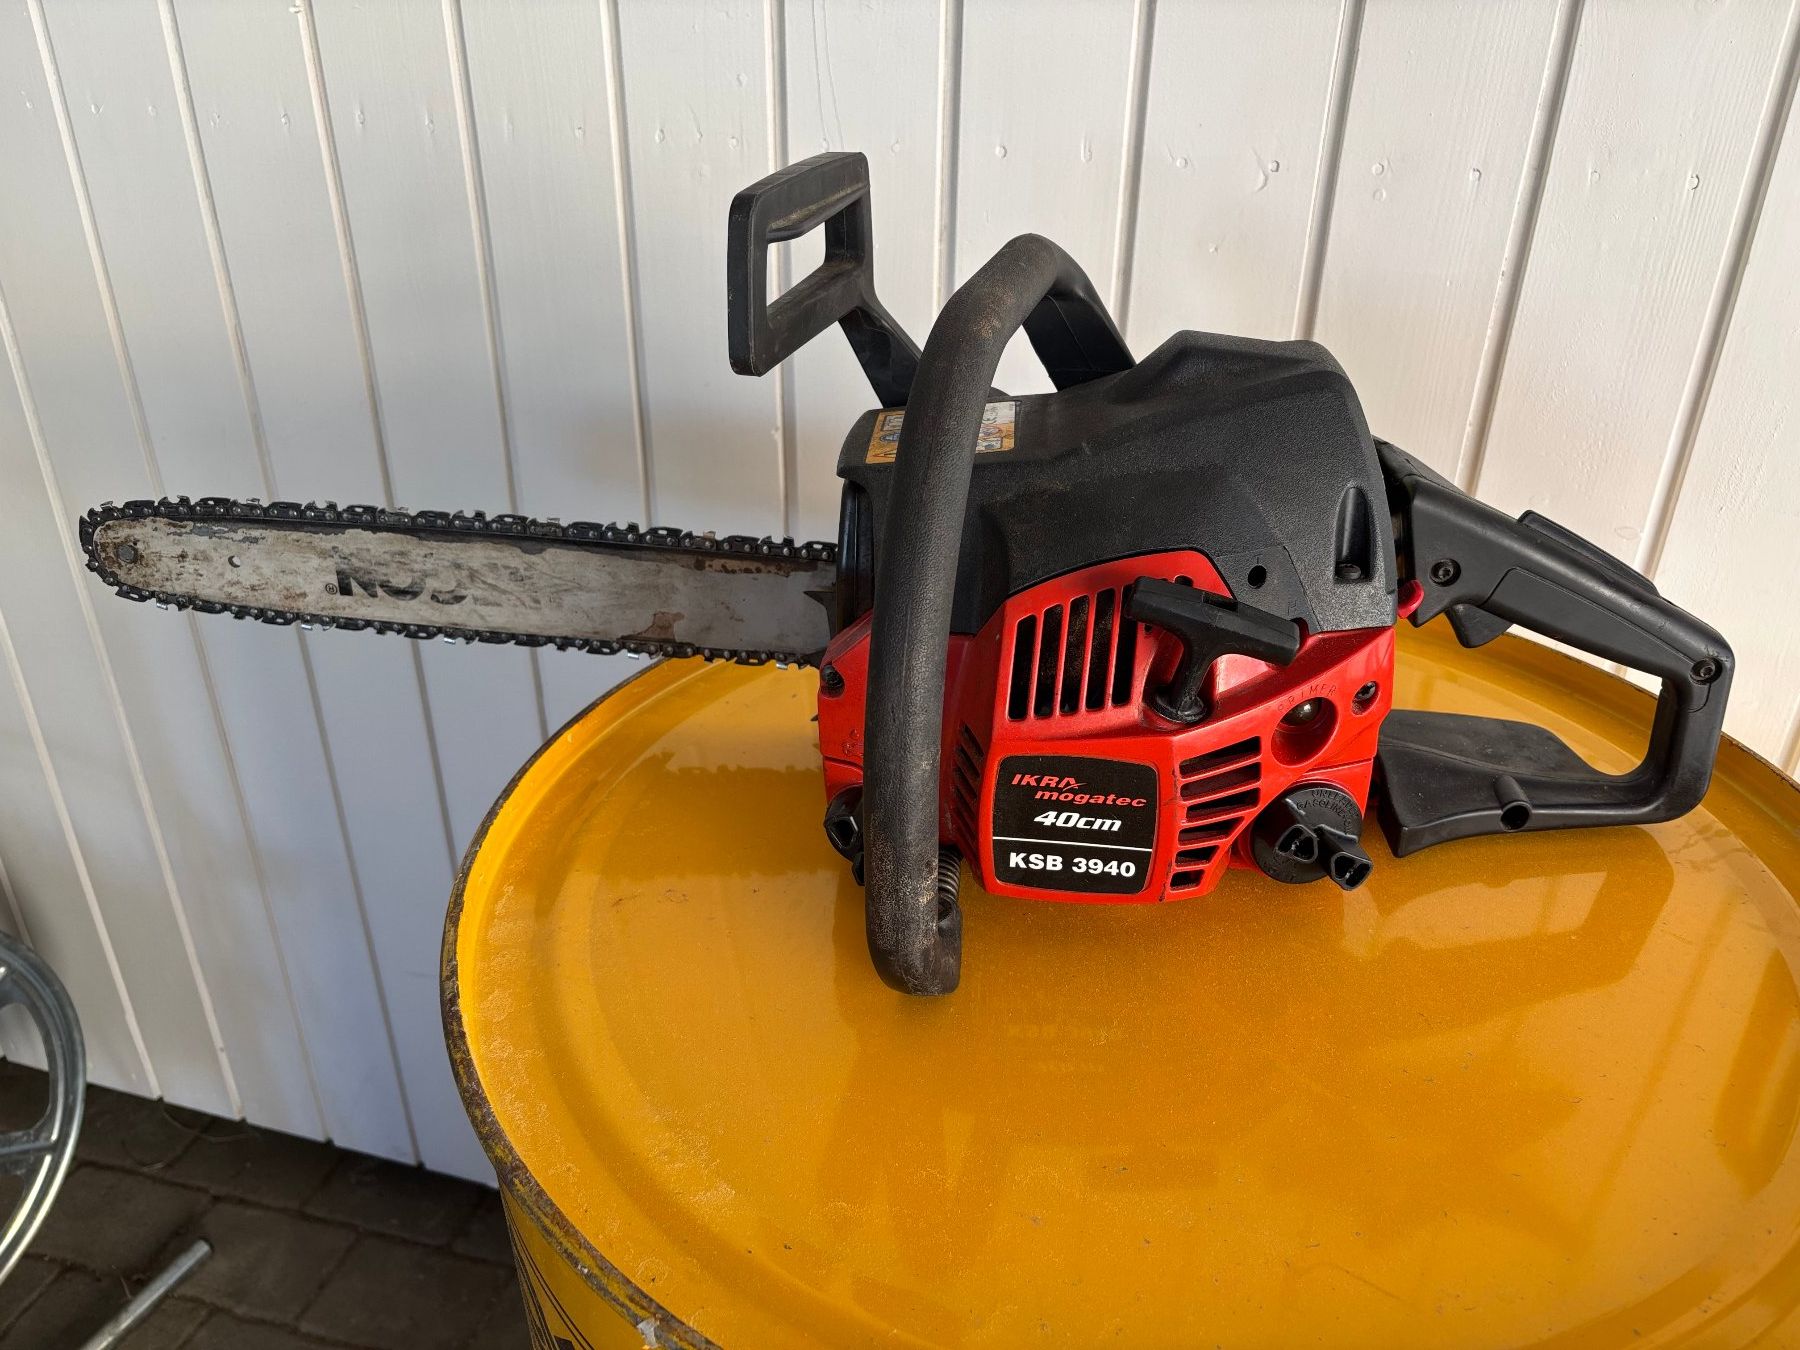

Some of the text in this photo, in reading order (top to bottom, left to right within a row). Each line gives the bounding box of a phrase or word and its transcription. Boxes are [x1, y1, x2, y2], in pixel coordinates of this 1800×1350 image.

[1011, 773, 1087, 792] IKRA
[1034, 790, 1147, 807] mogatec
[1033, 810, 1122, 832] 40cm
[1009, 852, 1136, 878] KSB 3940
